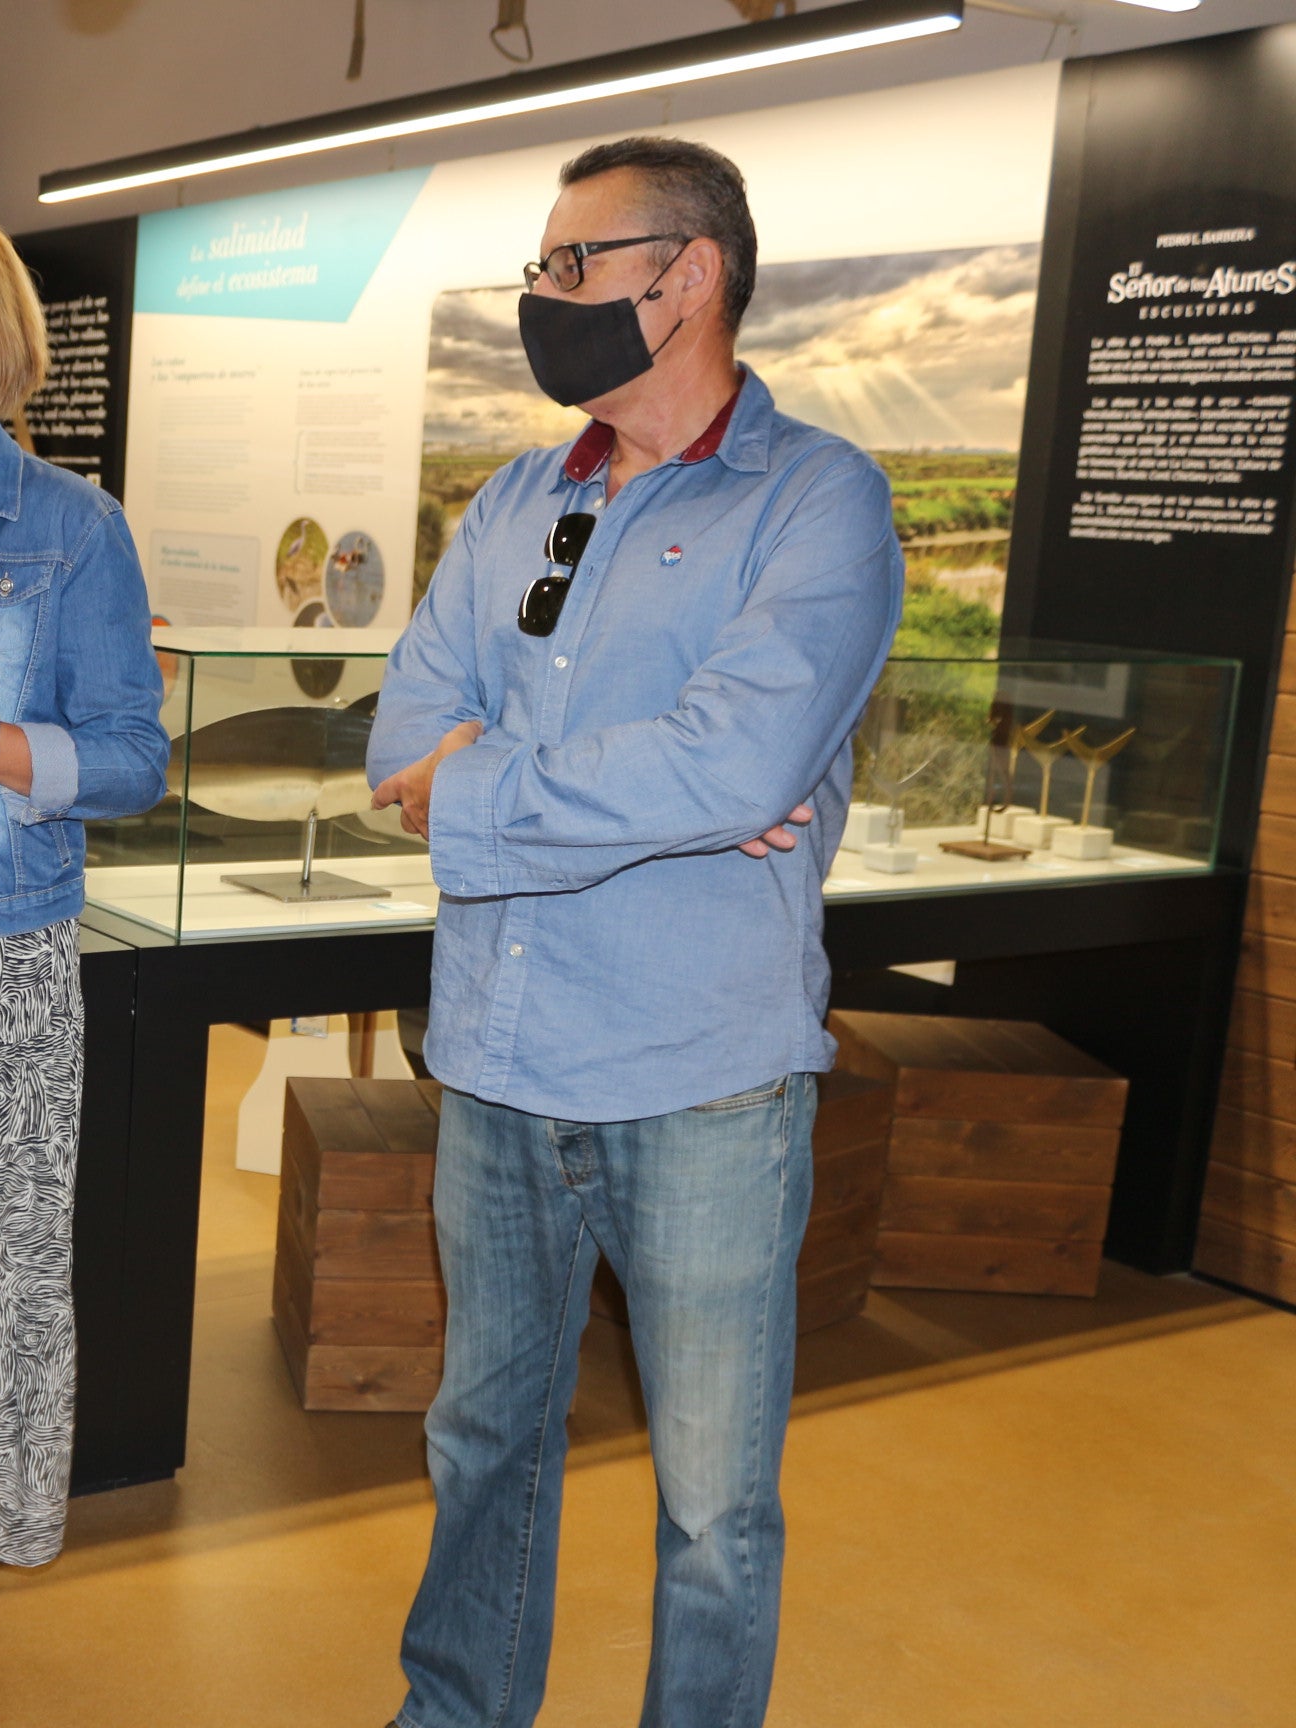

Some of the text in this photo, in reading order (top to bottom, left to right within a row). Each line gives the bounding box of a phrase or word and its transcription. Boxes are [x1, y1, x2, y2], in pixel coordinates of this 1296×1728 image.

[208, 212, 308, 260] salinidad
[1156, 233, 1192, 249] PEDRO
[175, 274, 211, 302] define
[227, 259, 319, 293] ecosistema
[1107, 272, 1179, 304] Señor
[1139, 300, 1256, 321] ESCULTURAS
